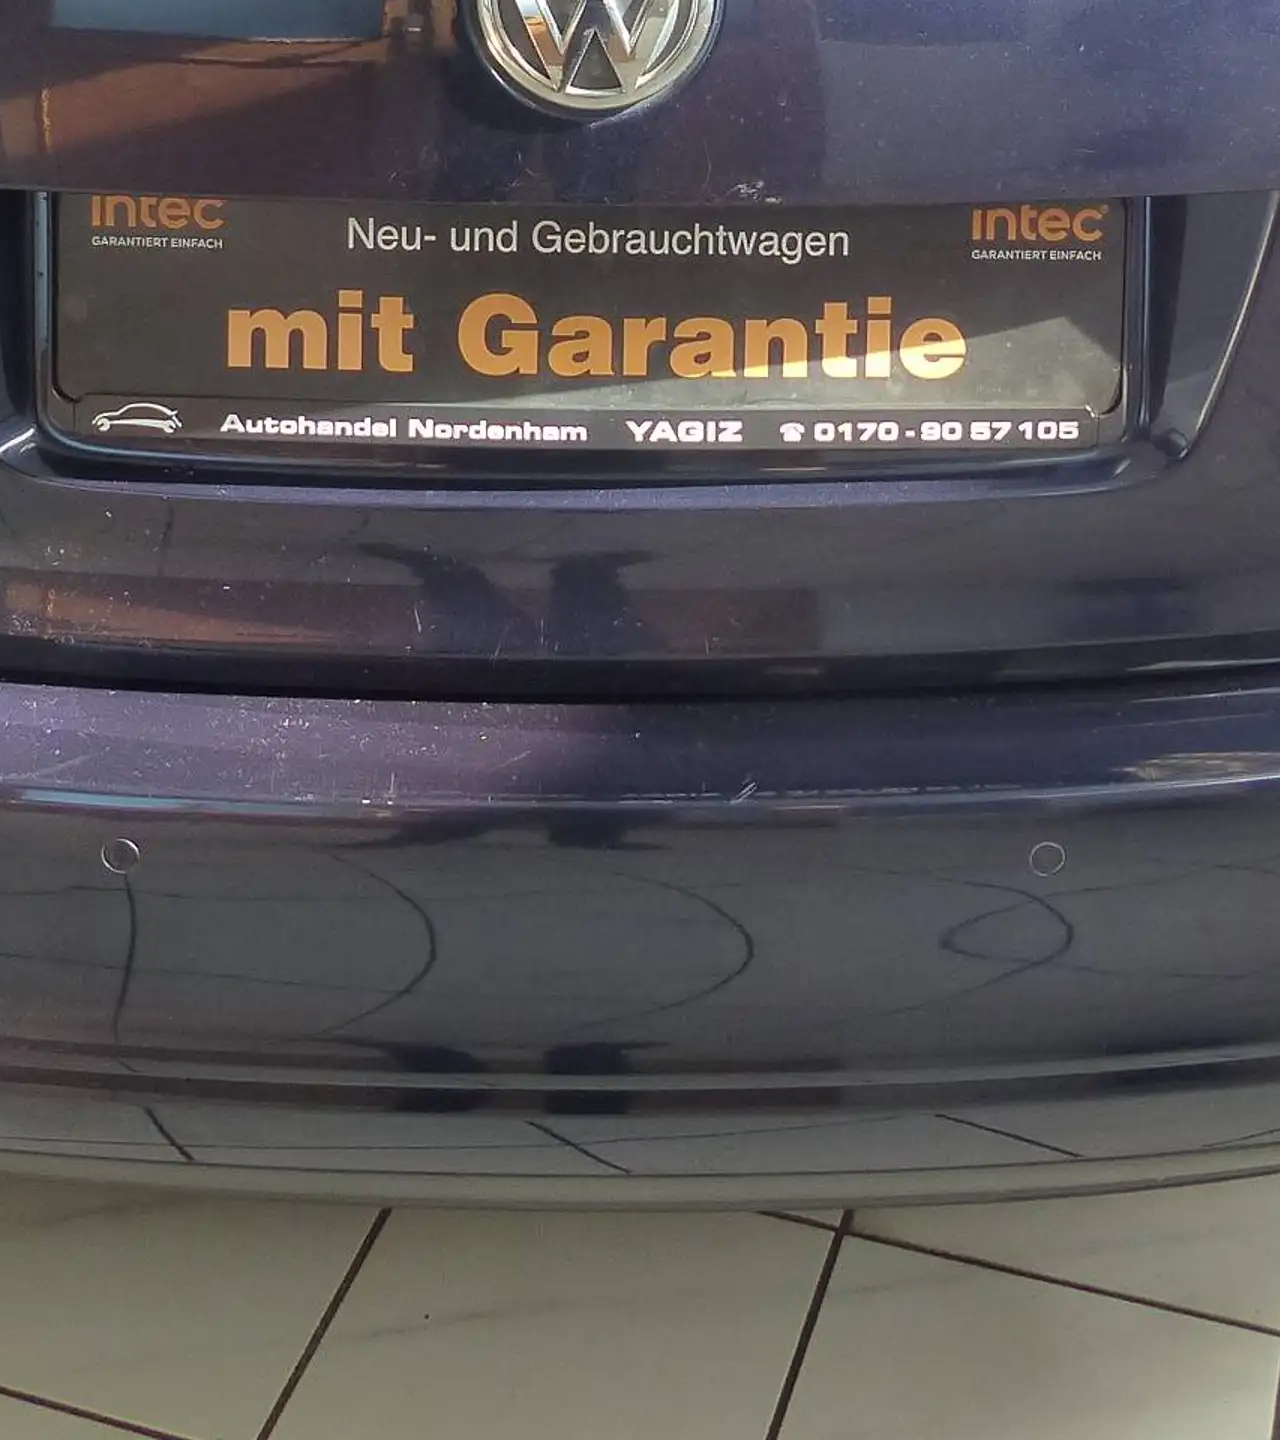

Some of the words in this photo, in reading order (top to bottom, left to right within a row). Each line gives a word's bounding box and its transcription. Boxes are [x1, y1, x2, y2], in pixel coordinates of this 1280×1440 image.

[91, 194, 224, 230] intec
[971, 204, 1105, 242] intec
[91, 235, 169, 248] GARANTIERT
[170, 237, 224, 250] EINFACH
[347, 216, 437, 252] Neu-
[450, 220, 519, 254] und
[531, 219, 850, 265] Gebrauchtwagen
[971, 248, 1049, 261] GARANTIERT
[1049, 249, 1102, 262] EINFACH
[227, 289, 416, 373] mit
[456, 293, 968, 381] Garantie
[219, 413, 398, 439] Autohandel
[407, 418, 589, 442] Nordenham
[625, 416, 745, 443] YAGIZ
[969, 421, 1013, 441] 57
[1016, 420, 1080, 441] 105
